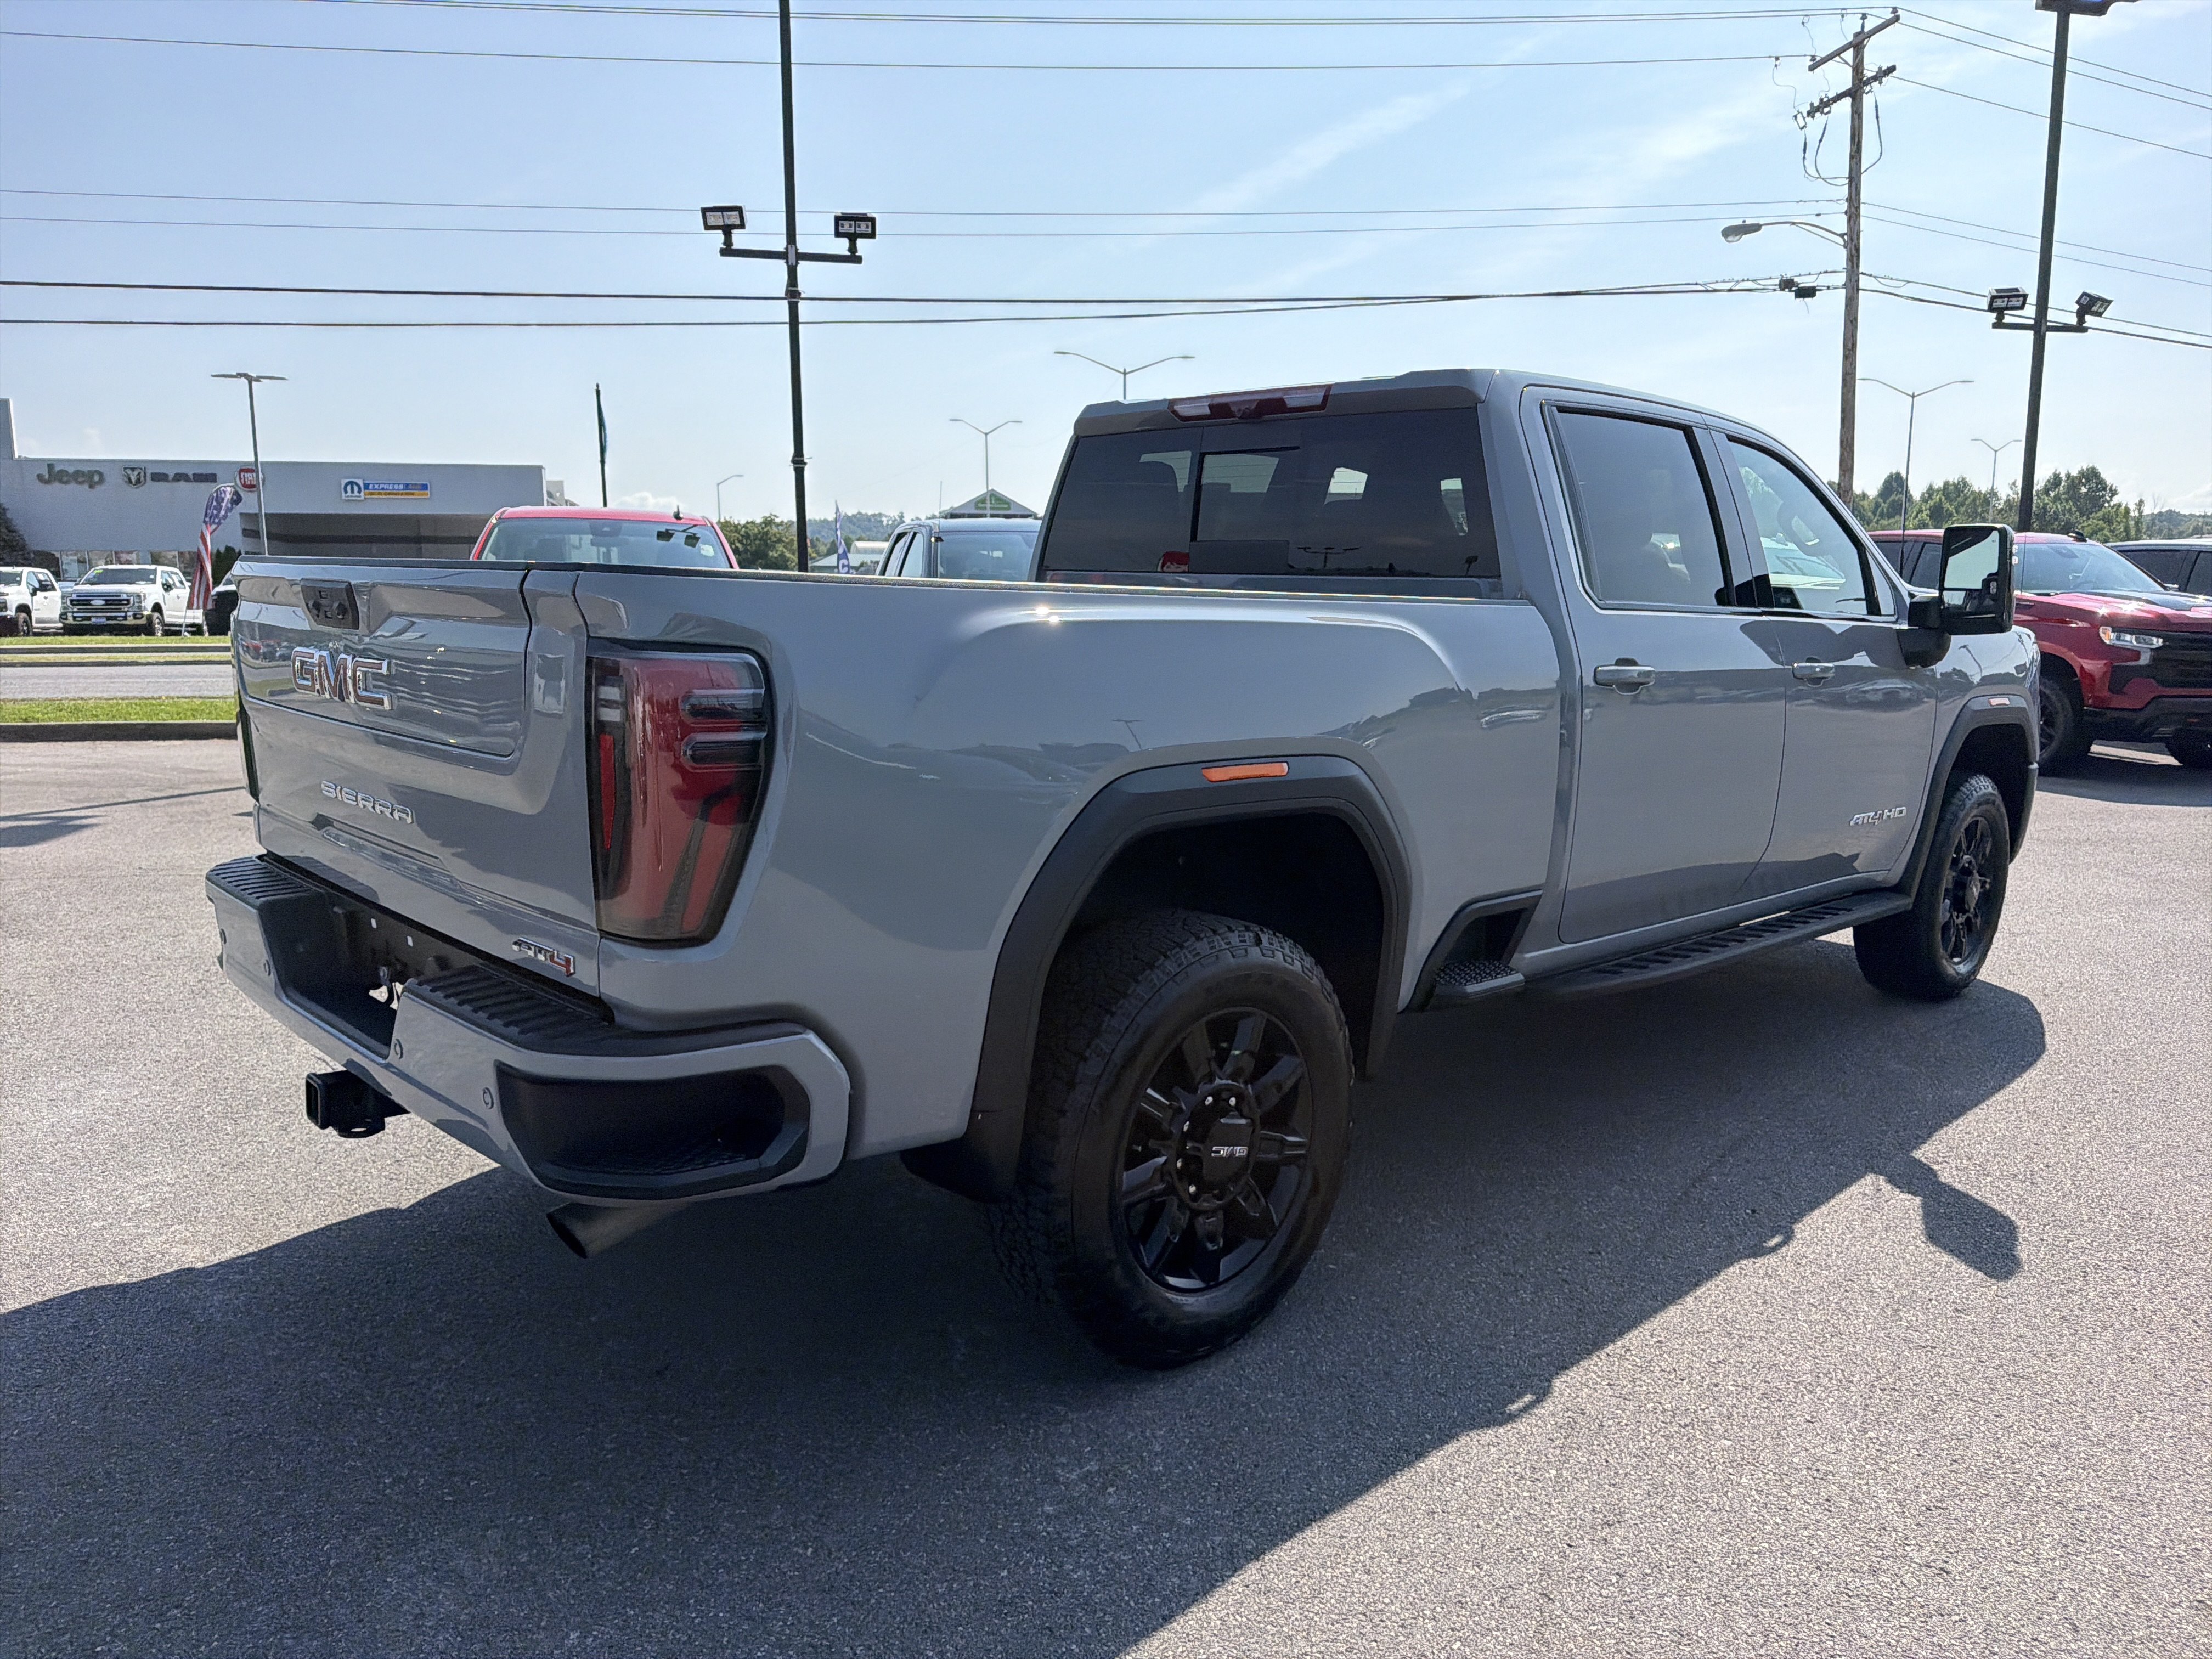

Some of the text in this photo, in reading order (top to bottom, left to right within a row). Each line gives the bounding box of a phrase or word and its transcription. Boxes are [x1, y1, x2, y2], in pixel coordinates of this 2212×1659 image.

[37, 463, 105, 489] Jeep
[151, 472, 218, 483] RAM
[291, 646, 393, 710] GMC
[321, 781, 414, 824] SIERRA
[512, 937, 575, 977] AT4
[1211, 1146, 1248, 1157] GMC
